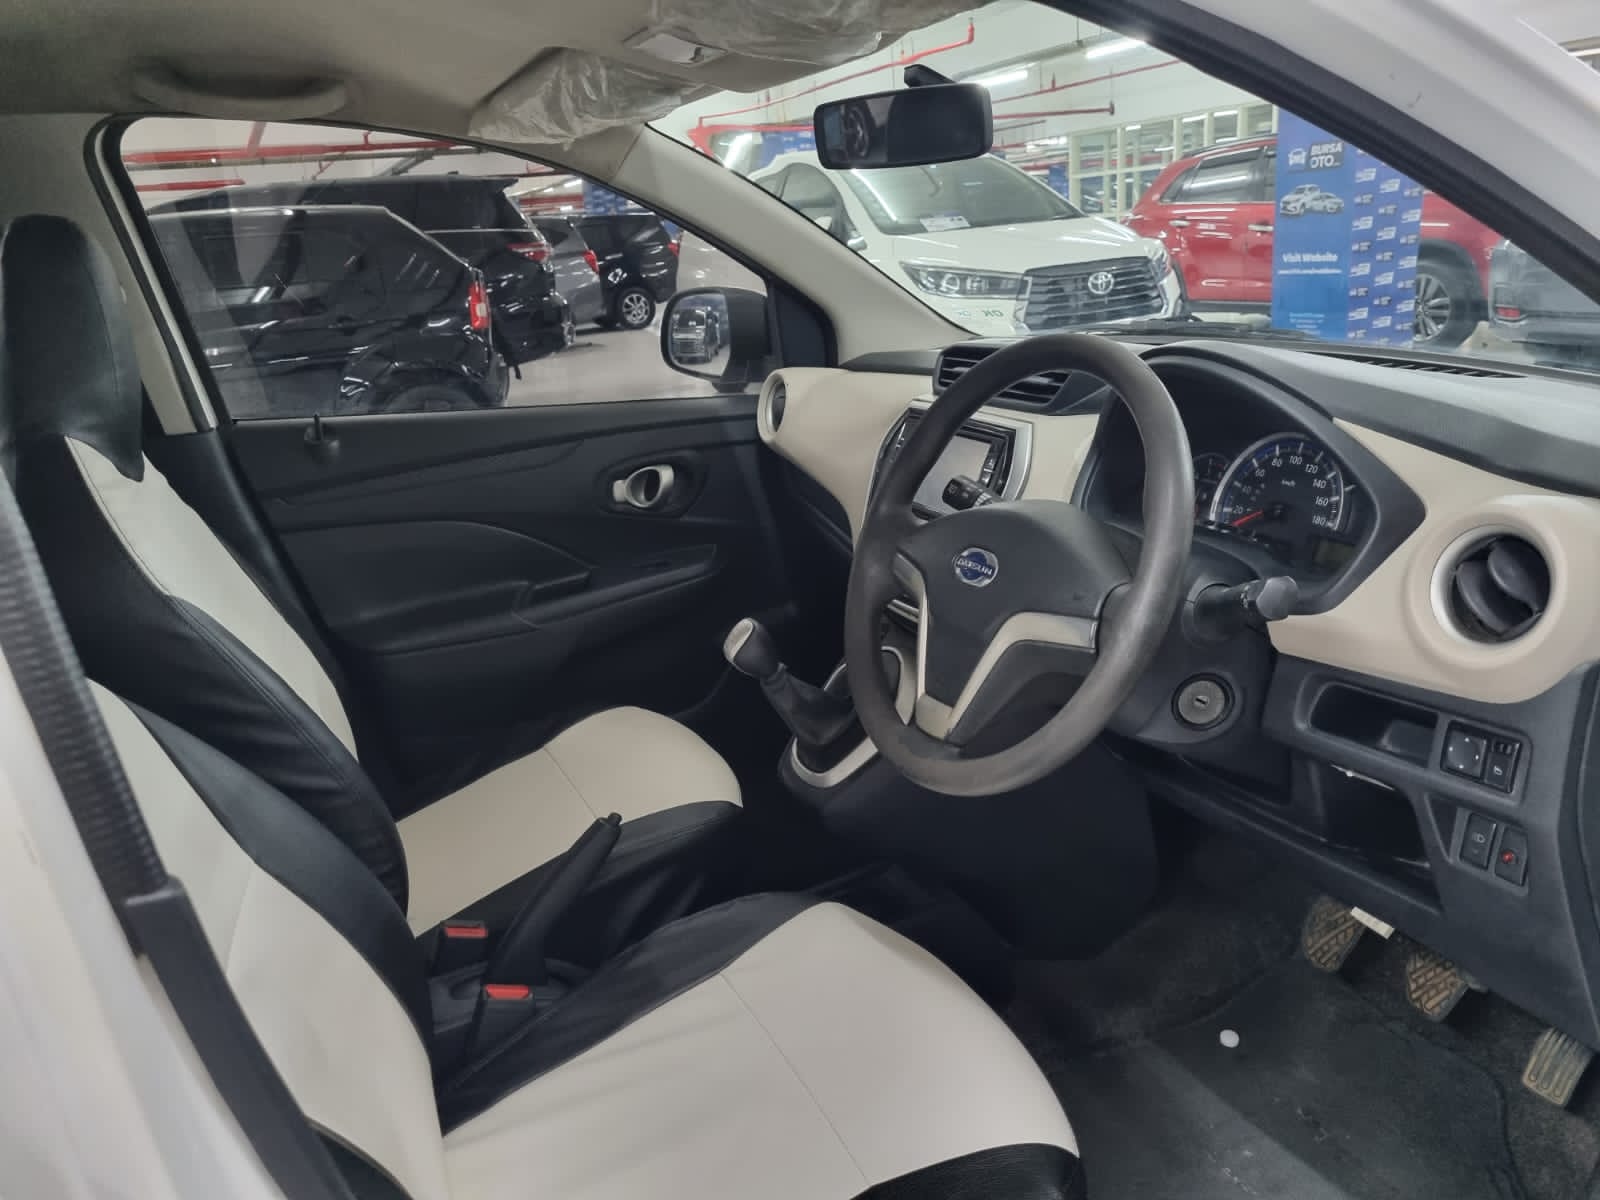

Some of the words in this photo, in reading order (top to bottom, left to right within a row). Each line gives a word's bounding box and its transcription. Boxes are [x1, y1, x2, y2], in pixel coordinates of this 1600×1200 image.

[1310, 154, 1335, 168] OTO
[1302, 251, 1338, 262] Website
[1272, 458, 1282, 467] 80
[1289, 455, 1302, 464] 100
[1305, 463, 1318, 474] 120
[1313, 479, 1326, 489] 140
[1315, 496, 1328, 506] 160
[1312, 515, 1326, 526] 180
